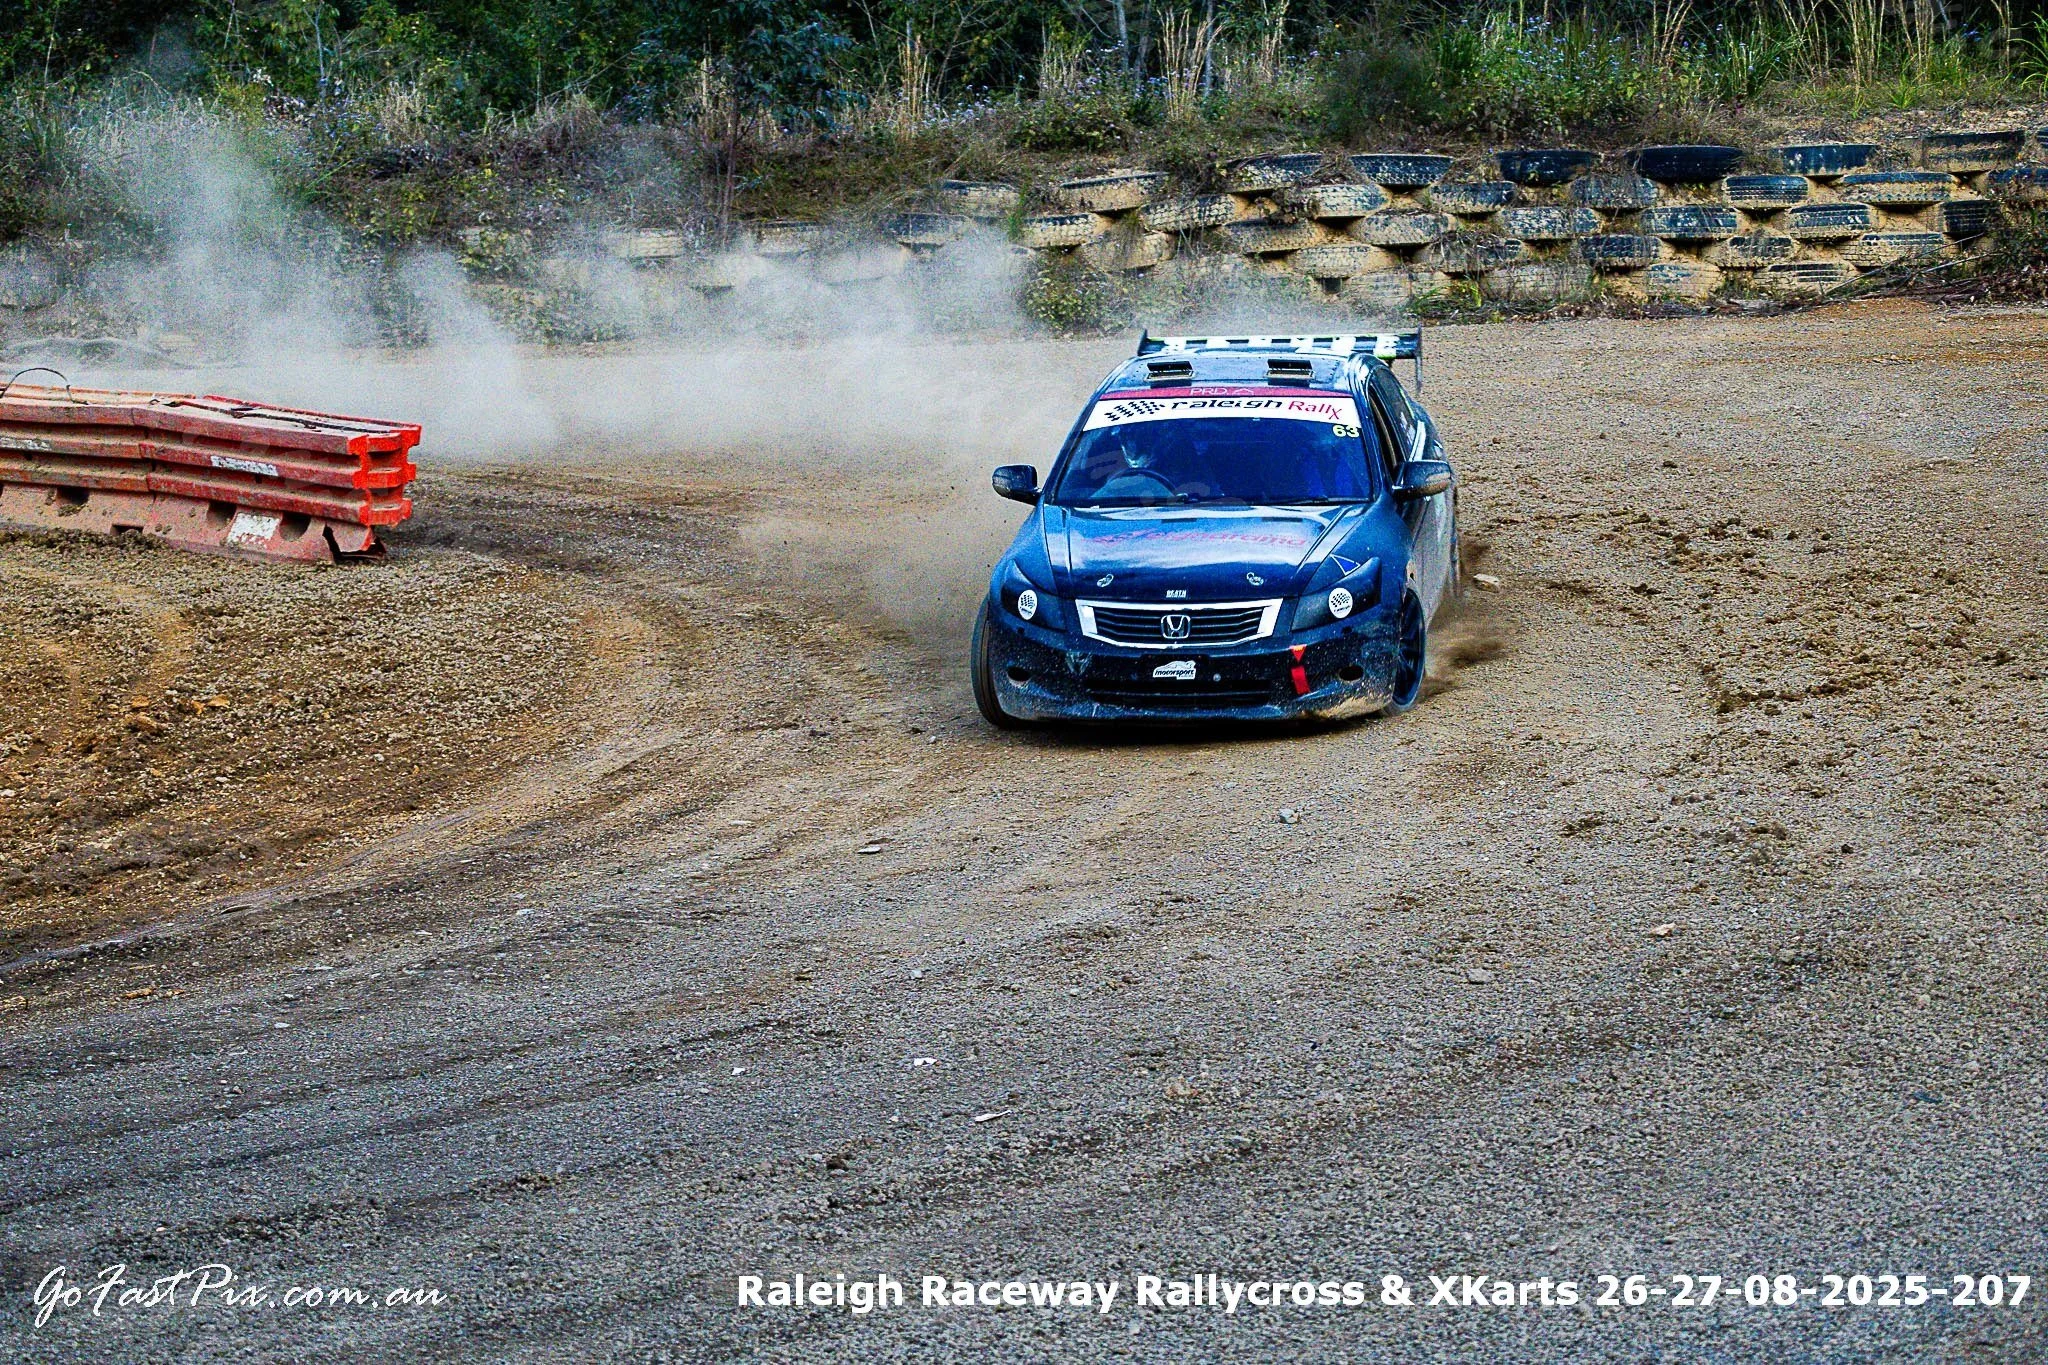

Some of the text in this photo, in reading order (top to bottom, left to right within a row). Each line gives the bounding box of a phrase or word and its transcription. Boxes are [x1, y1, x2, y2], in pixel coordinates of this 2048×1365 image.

[1171, 399, 1283, 410] raleigh
[1332, 424, 1360, 438] 63
[1154, 669, 1195, 678] motorsport
